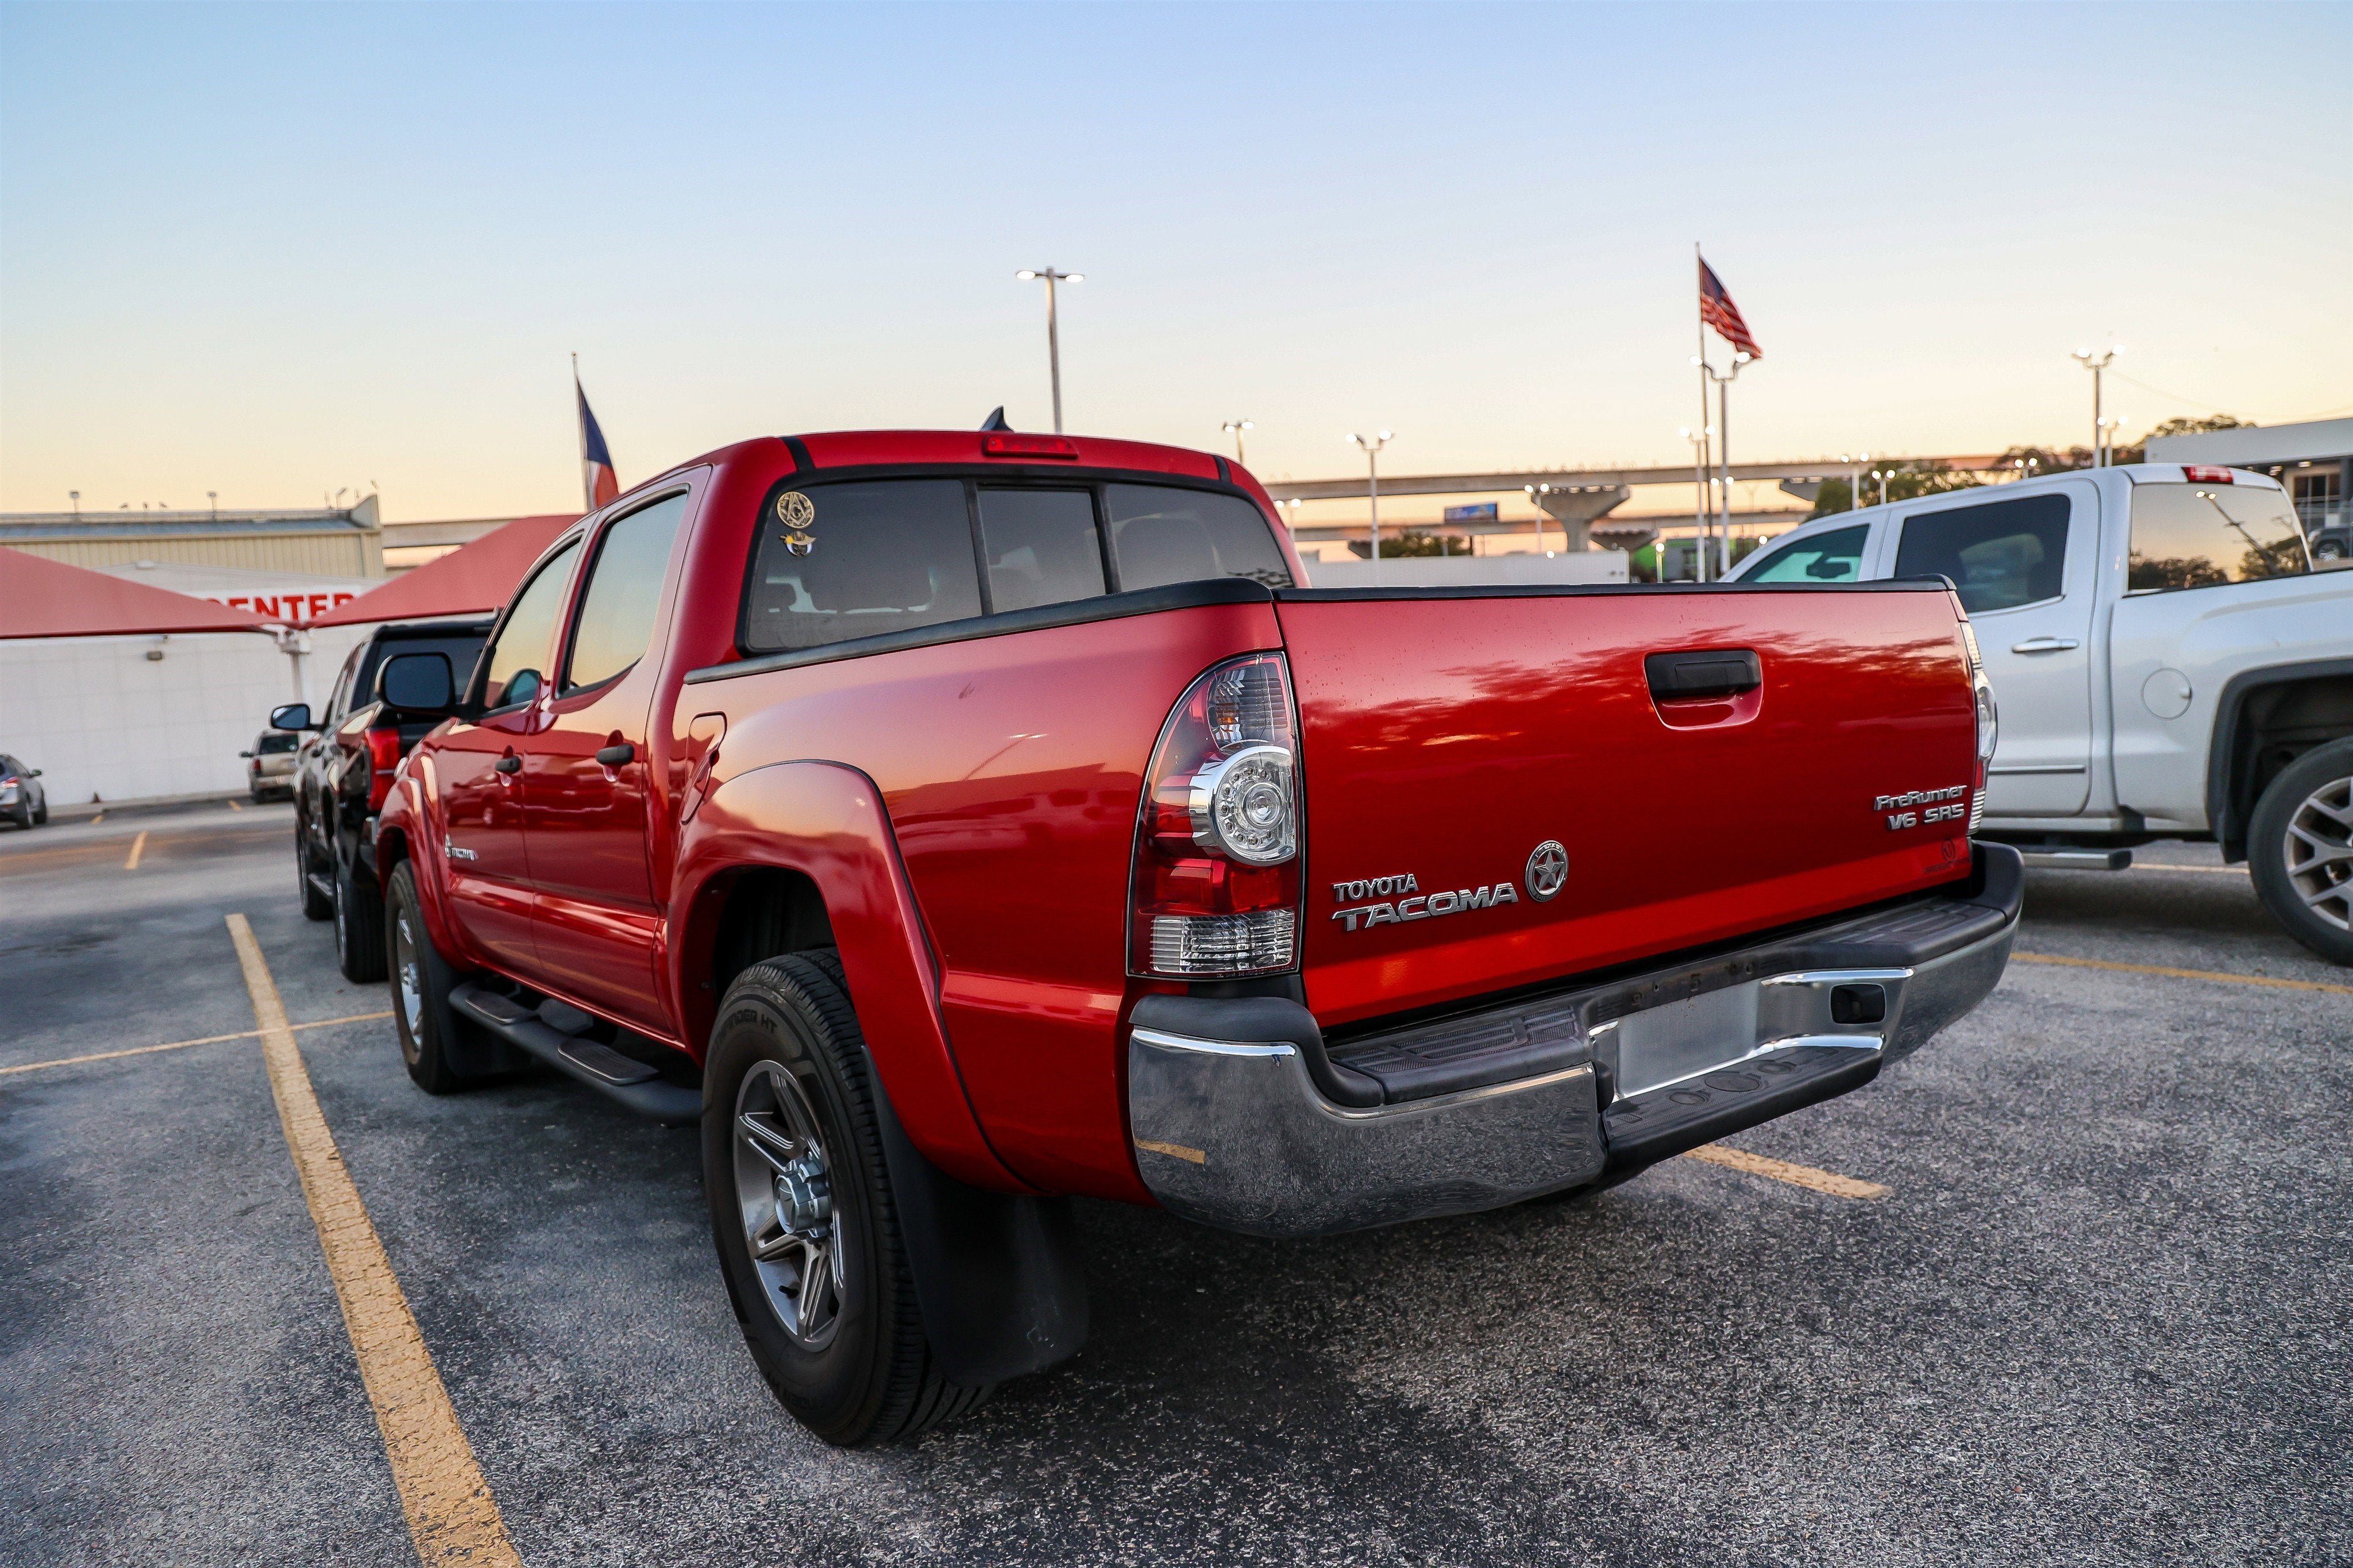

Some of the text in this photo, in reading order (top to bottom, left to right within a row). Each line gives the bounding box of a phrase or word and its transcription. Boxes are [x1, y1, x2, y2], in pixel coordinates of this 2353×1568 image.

[205, 593, 355, 621] NTE
[1874, 785, 1968, 811] PreRunner
[1887, 803, 1965, 830] V6 SR5
[1333, 872, 1419, 903] TOYOTA
[1330, 882, 1519, 932] TACOMA
